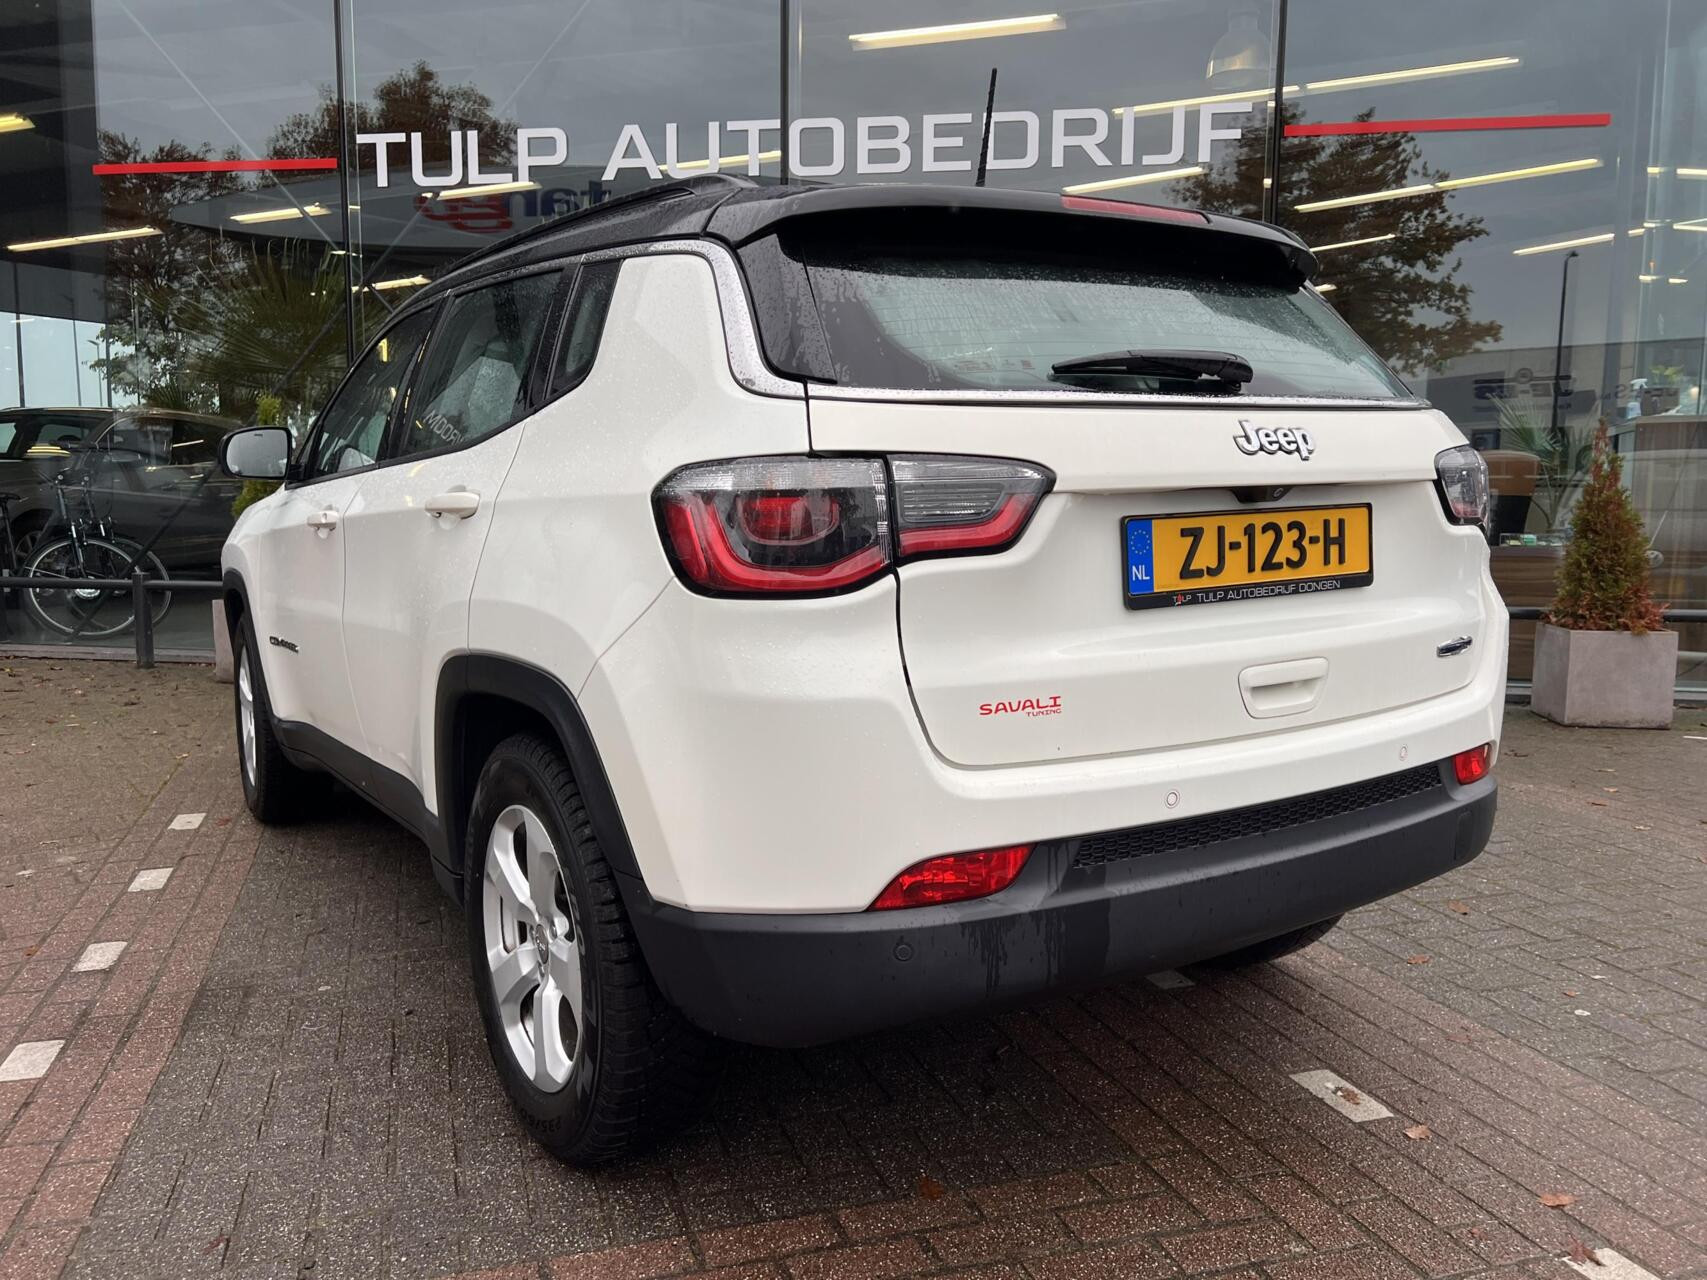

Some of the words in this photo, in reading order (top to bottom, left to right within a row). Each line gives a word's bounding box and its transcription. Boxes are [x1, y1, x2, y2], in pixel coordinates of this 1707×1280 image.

[355, 127, 568, 188] TULP
[601, 101, 1254, 181] AUTOBEDRIJF
[1232, 419, 1316, 461] Jeep
[1178, 517, 1346, 580] ZJ-123-H
[1132, 564, 1150, 582] NL
[1196, 591, 1224, 603] TULP
[1227, 584, 1297, 600] AUTOBEDRIJF
[1299, 580, 1341, 593] DONGEN
[979, 696, 1062, 716] SAVALI
[1026, 708, 1062, 718] TUNING
